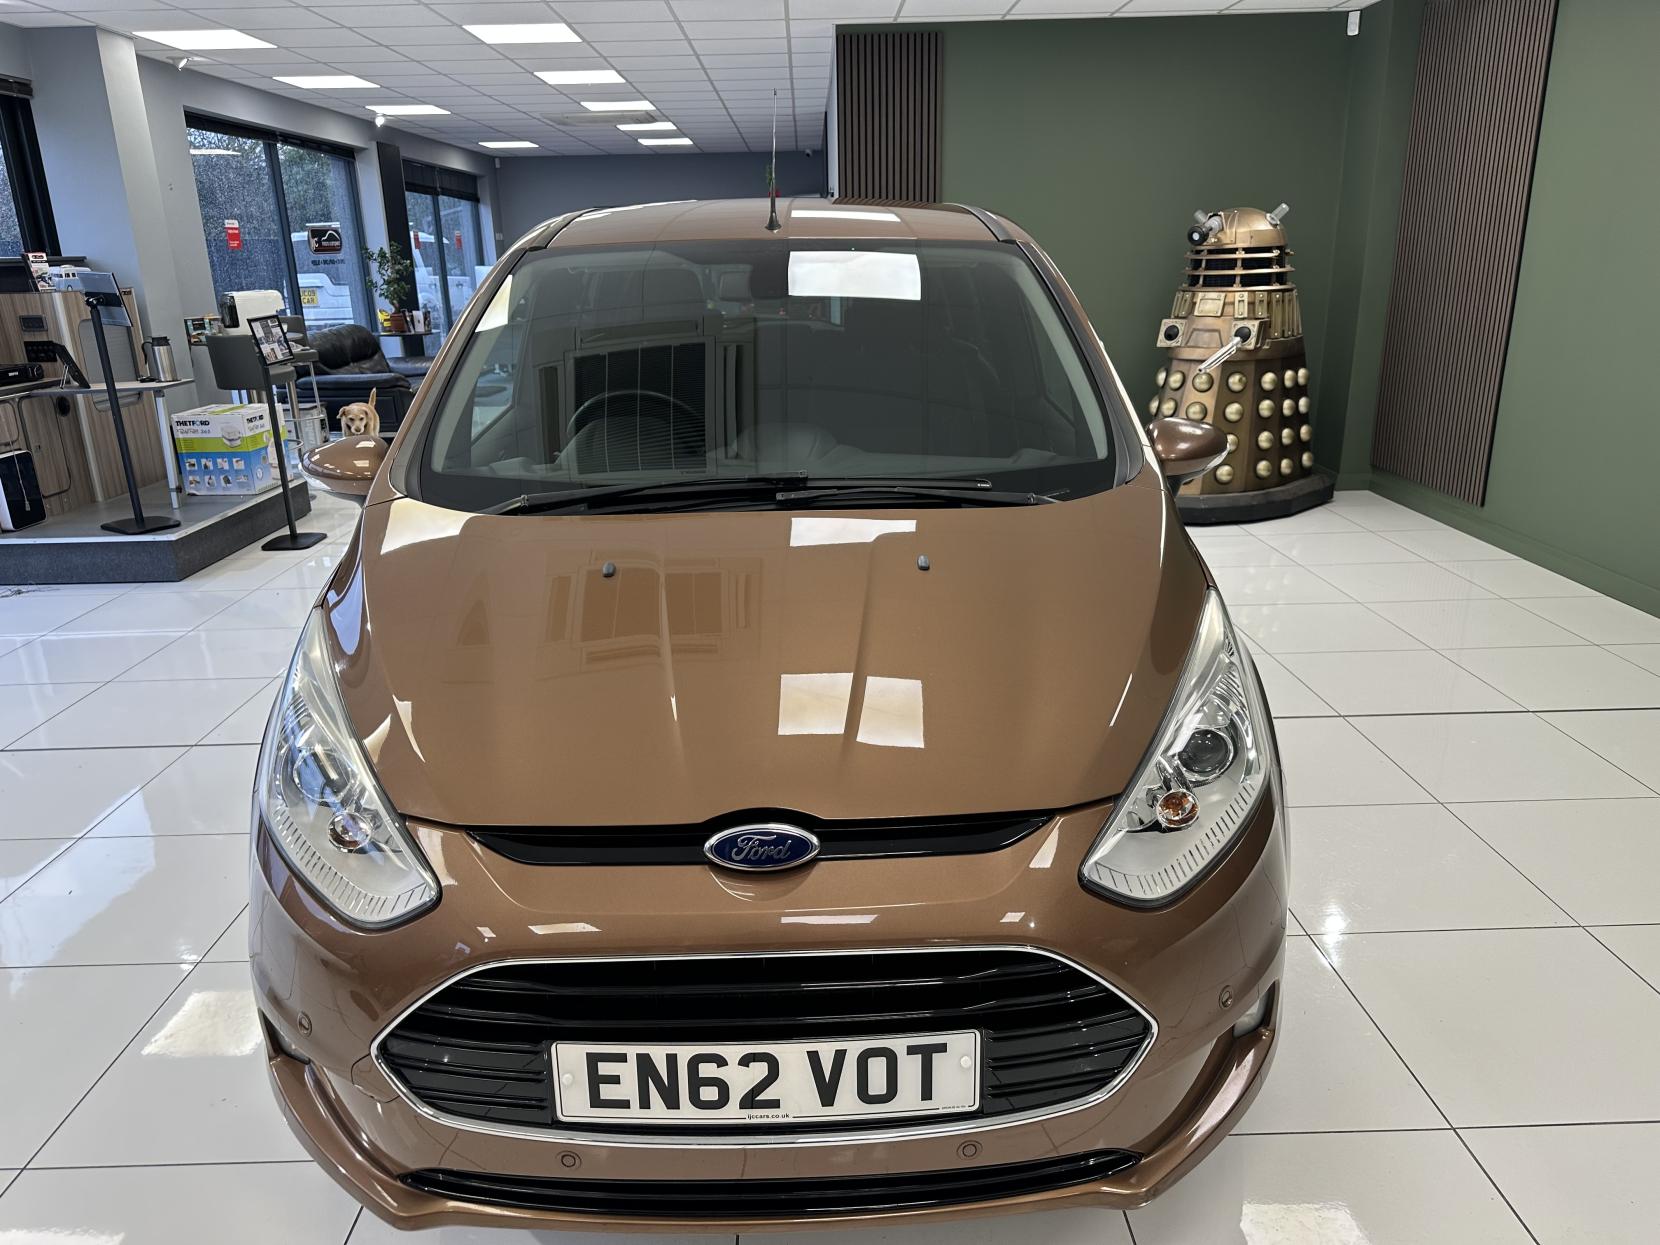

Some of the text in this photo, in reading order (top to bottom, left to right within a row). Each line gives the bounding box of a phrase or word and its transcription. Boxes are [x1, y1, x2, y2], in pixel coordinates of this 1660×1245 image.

[731, 834, 792, 861] Ford
[585, 1042, 947, 1111] EN62 VOT
